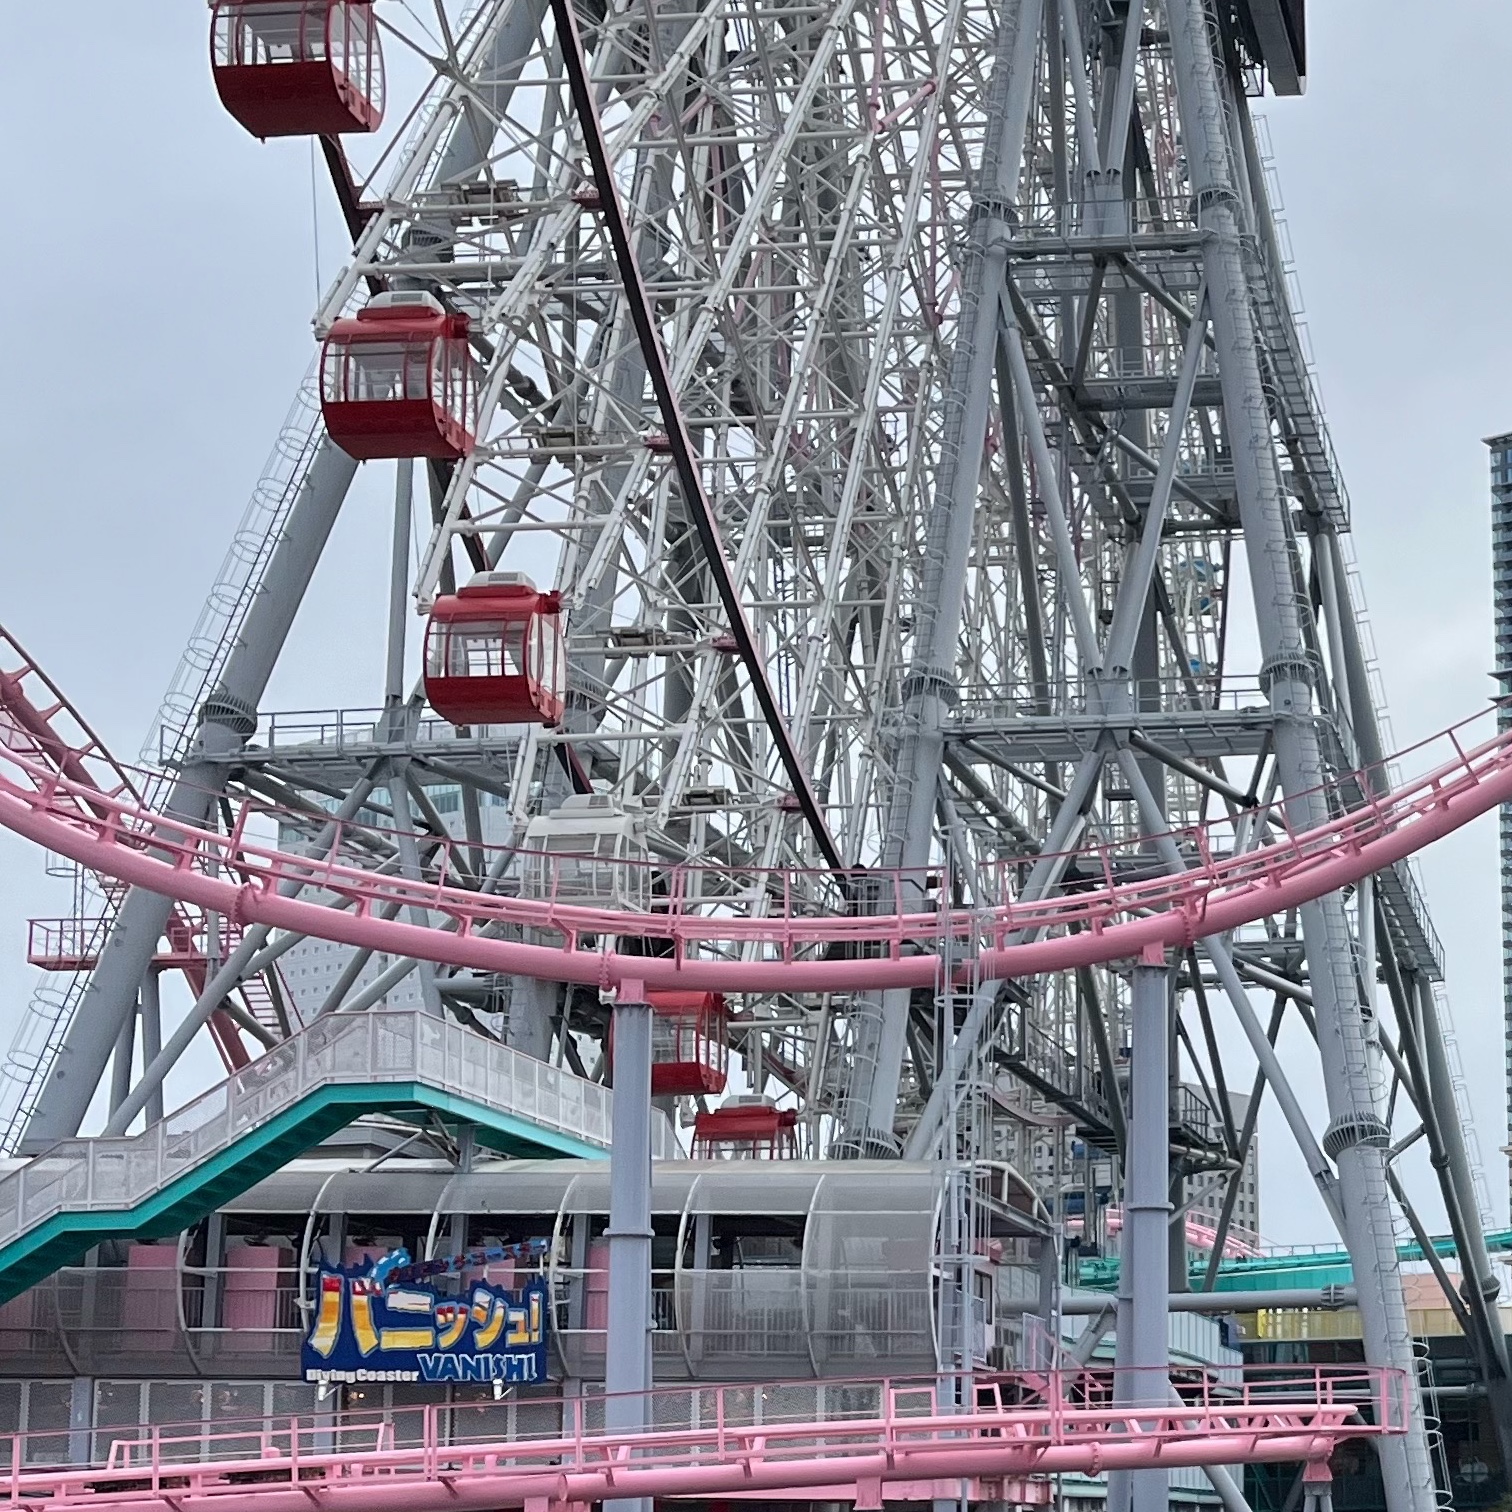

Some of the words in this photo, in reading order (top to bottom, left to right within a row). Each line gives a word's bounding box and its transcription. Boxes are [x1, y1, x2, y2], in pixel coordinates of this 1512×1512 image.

[308, 1271, 544, 1359] バニッシュ!
[416, 1352, 538, 1382] VANISH!
